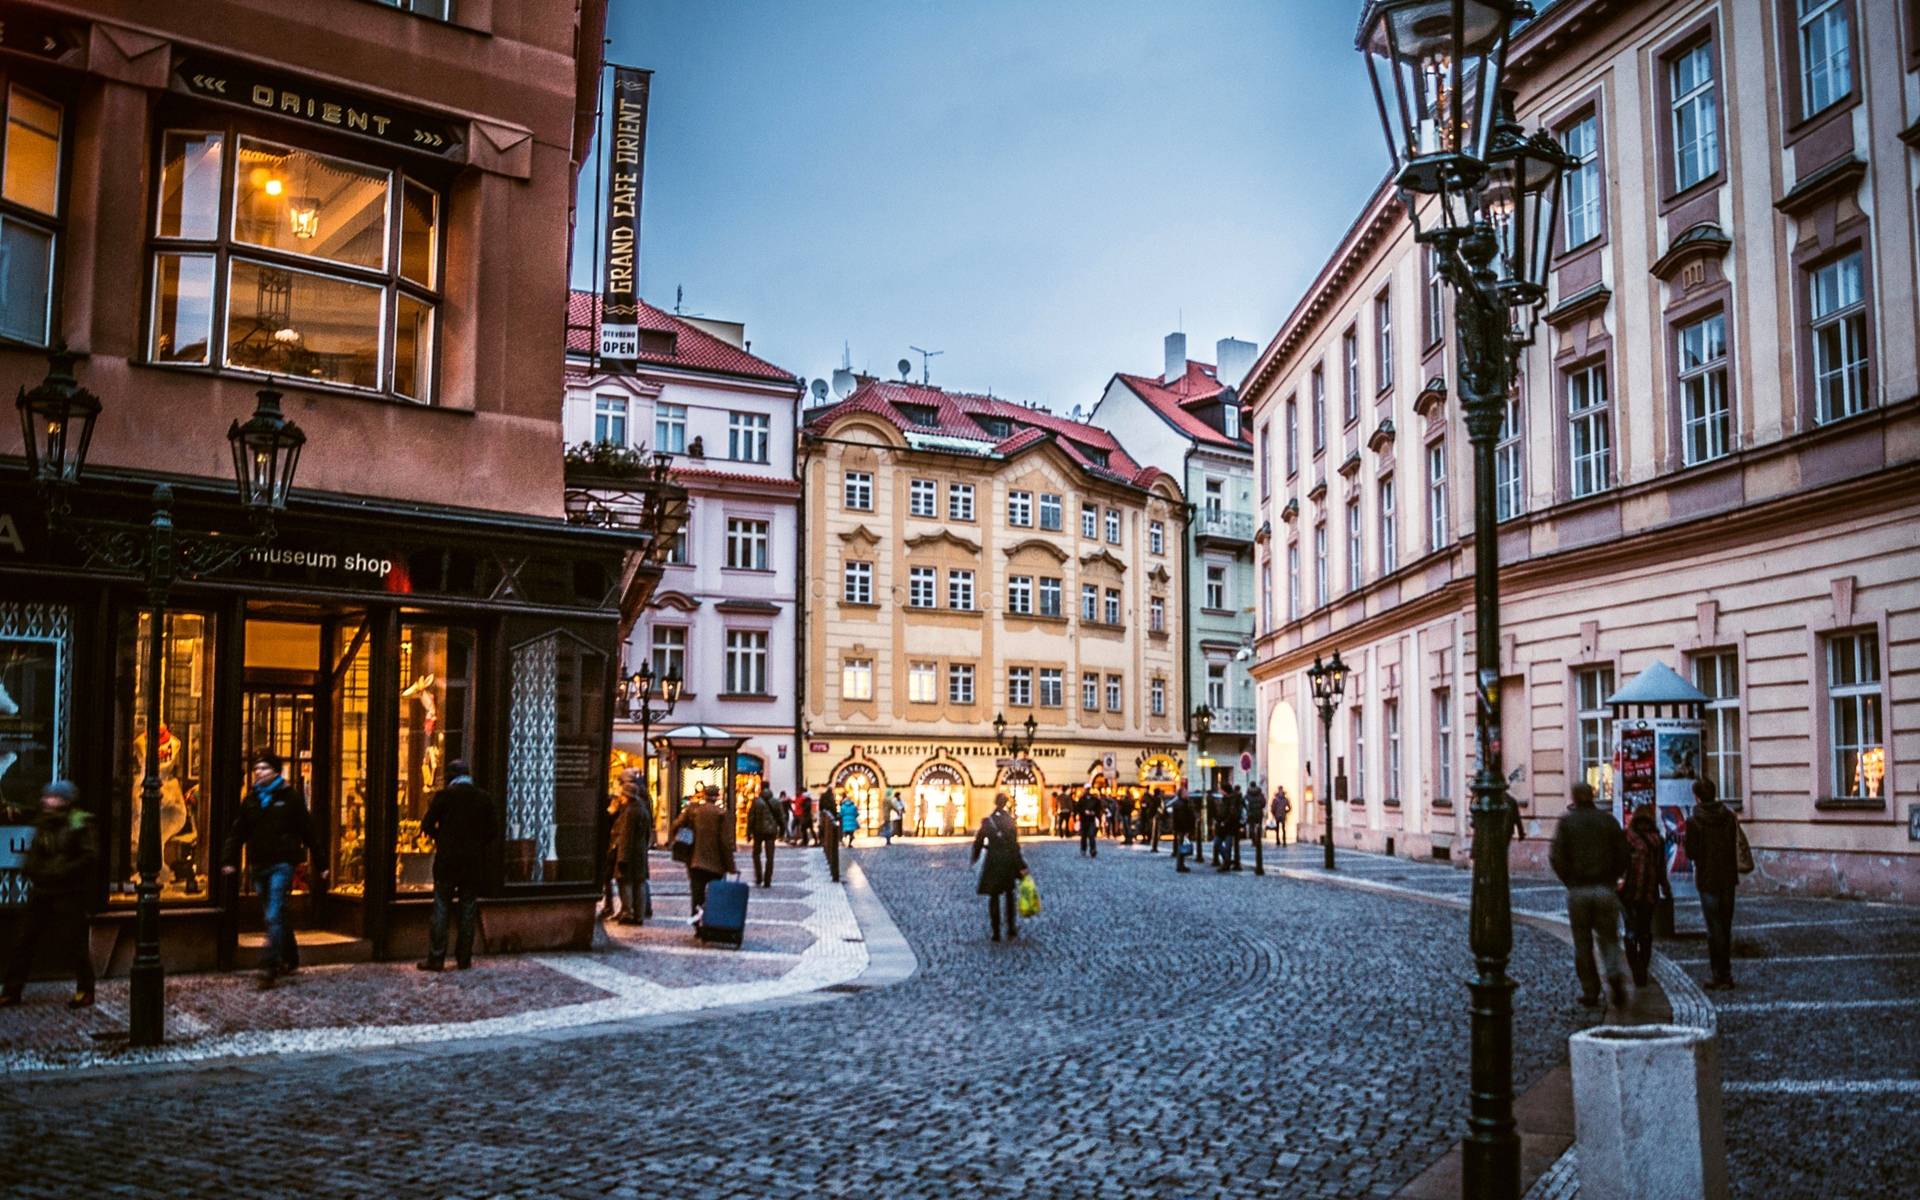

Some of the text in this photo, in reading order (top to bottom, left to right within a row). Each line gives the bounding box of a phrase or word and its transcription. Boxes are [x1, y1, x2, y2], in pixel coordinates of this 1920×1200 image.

[252, 84, 391, 135] ORIENT
[610, 98, 642, 294] GRAND CAFE ORIENT
[603, 341, 635, 354] OPEN
[344, 553, 392, 577] shop
[866, 743, 934, 756] ZLATNICTVÍ
